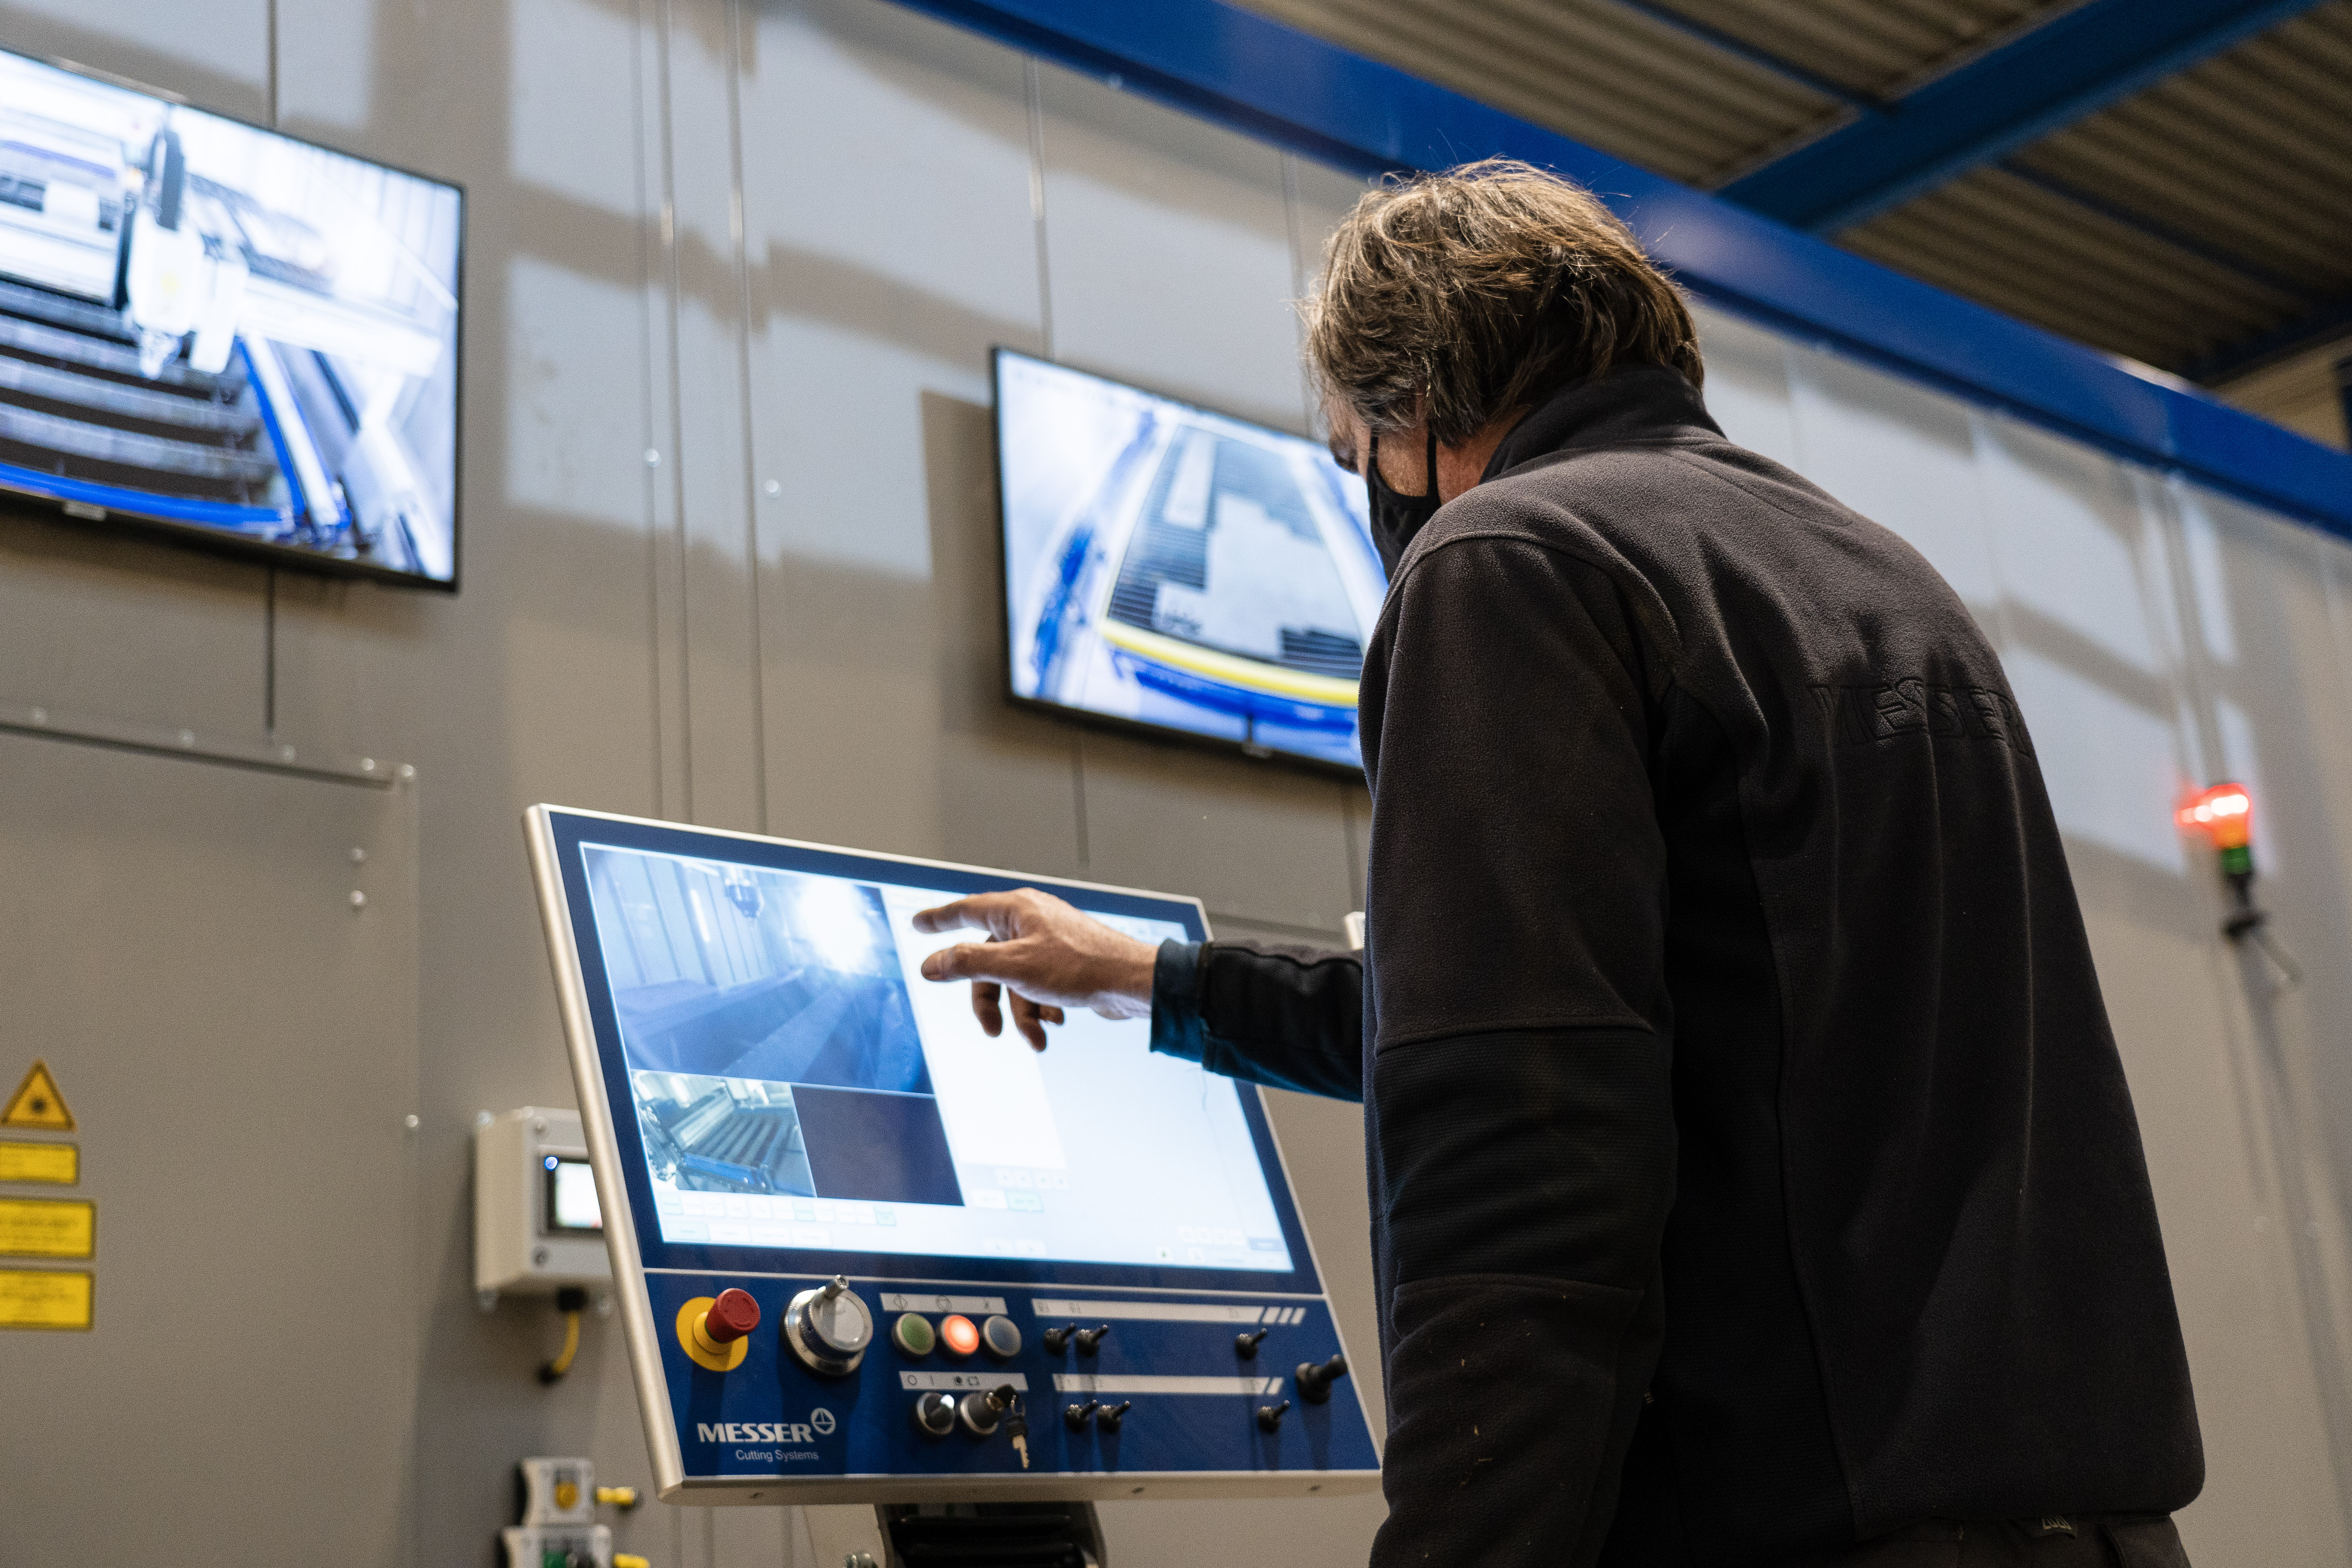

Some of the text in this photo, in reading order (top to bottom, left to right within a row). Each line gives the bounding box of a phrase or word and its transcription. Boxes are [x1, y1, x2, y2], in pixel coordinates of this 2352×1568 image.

[697, 1423, 815, 1443] MESSER
[735, 1449, 819, 1463] Cutting Systems
